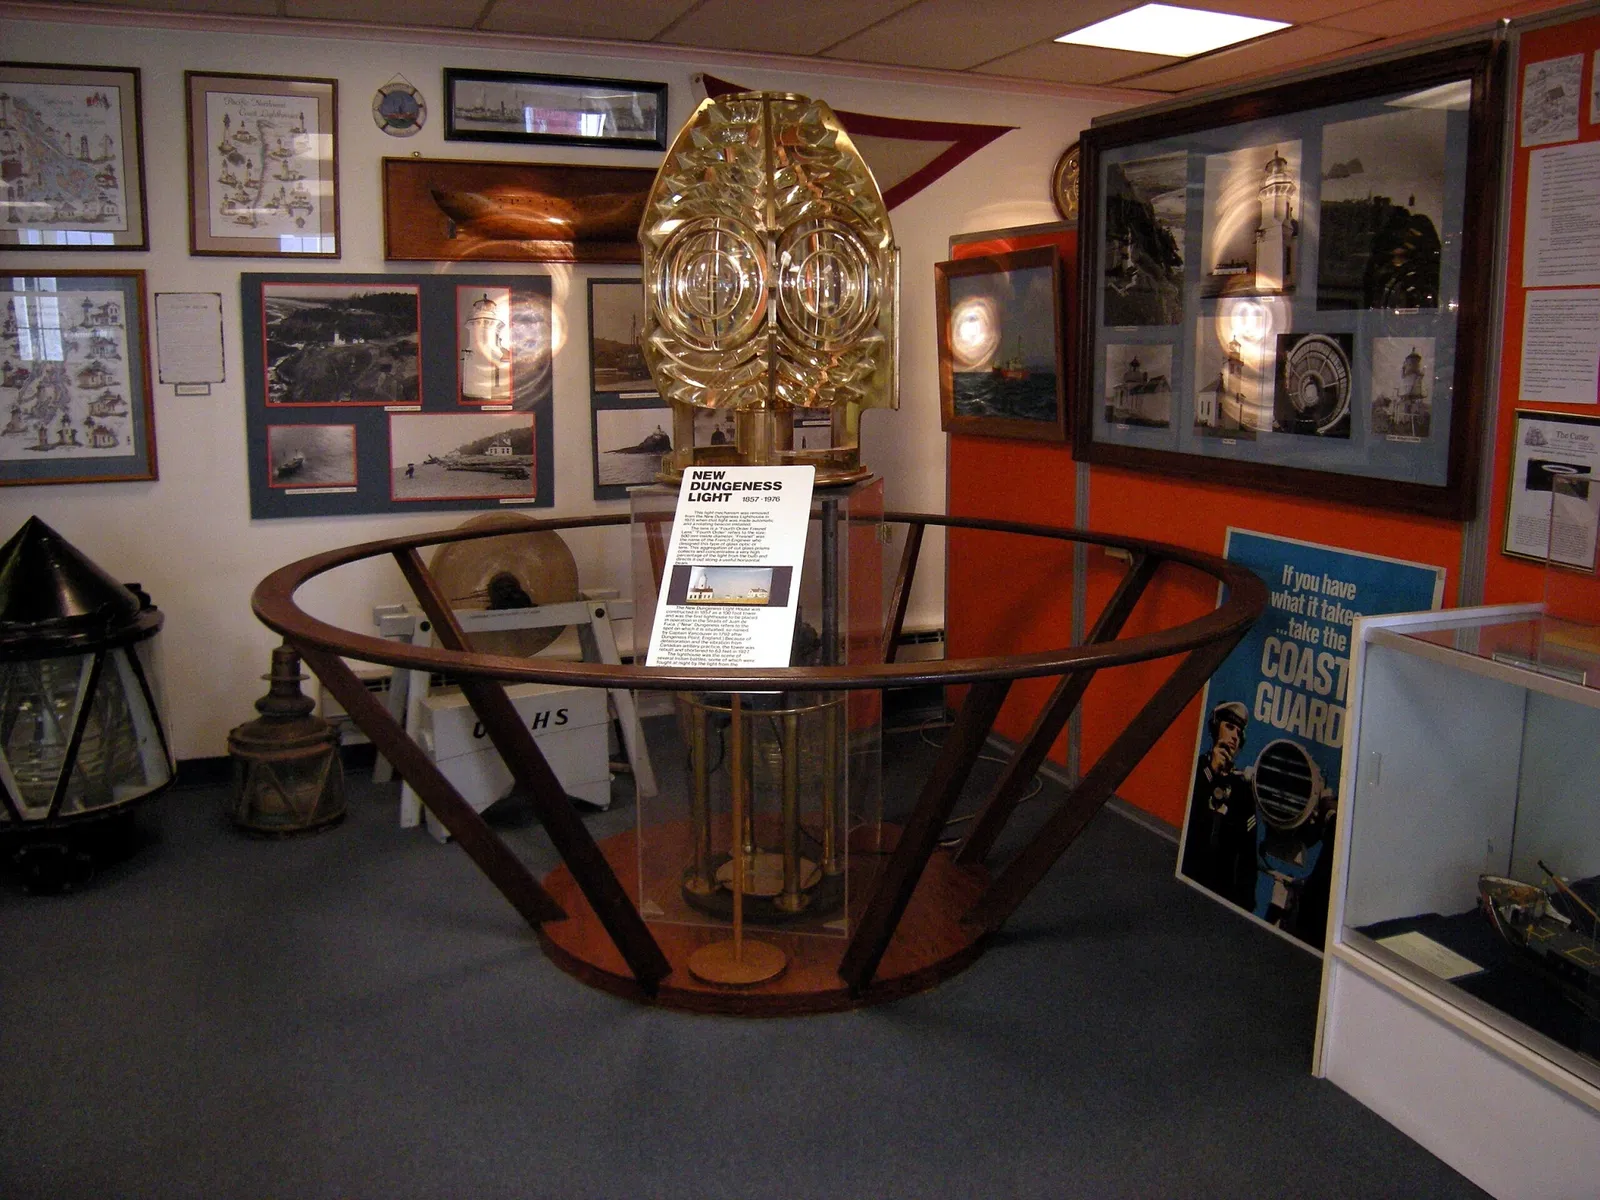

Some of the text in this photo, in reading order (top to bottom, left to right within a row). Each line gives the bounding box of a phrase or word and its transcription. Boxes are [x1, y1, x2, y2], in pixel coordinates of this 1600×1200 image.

[1556, 430, 1569, 439] The
[690, 482, 782, 491] DUNGENESS
[692, 471, 726, 480] NEW
[688, 493, 732, 502] LIGHT
[1282, 564, 1356, 600] If you have
[1272, 590, 1305, 614] what
[1307, 596, 1318, 618] it
[1323, 626, 1346, 652] the
[1262, 636, 1350, 700] COAST
[1254, 681, 1346, 748] GUARD
